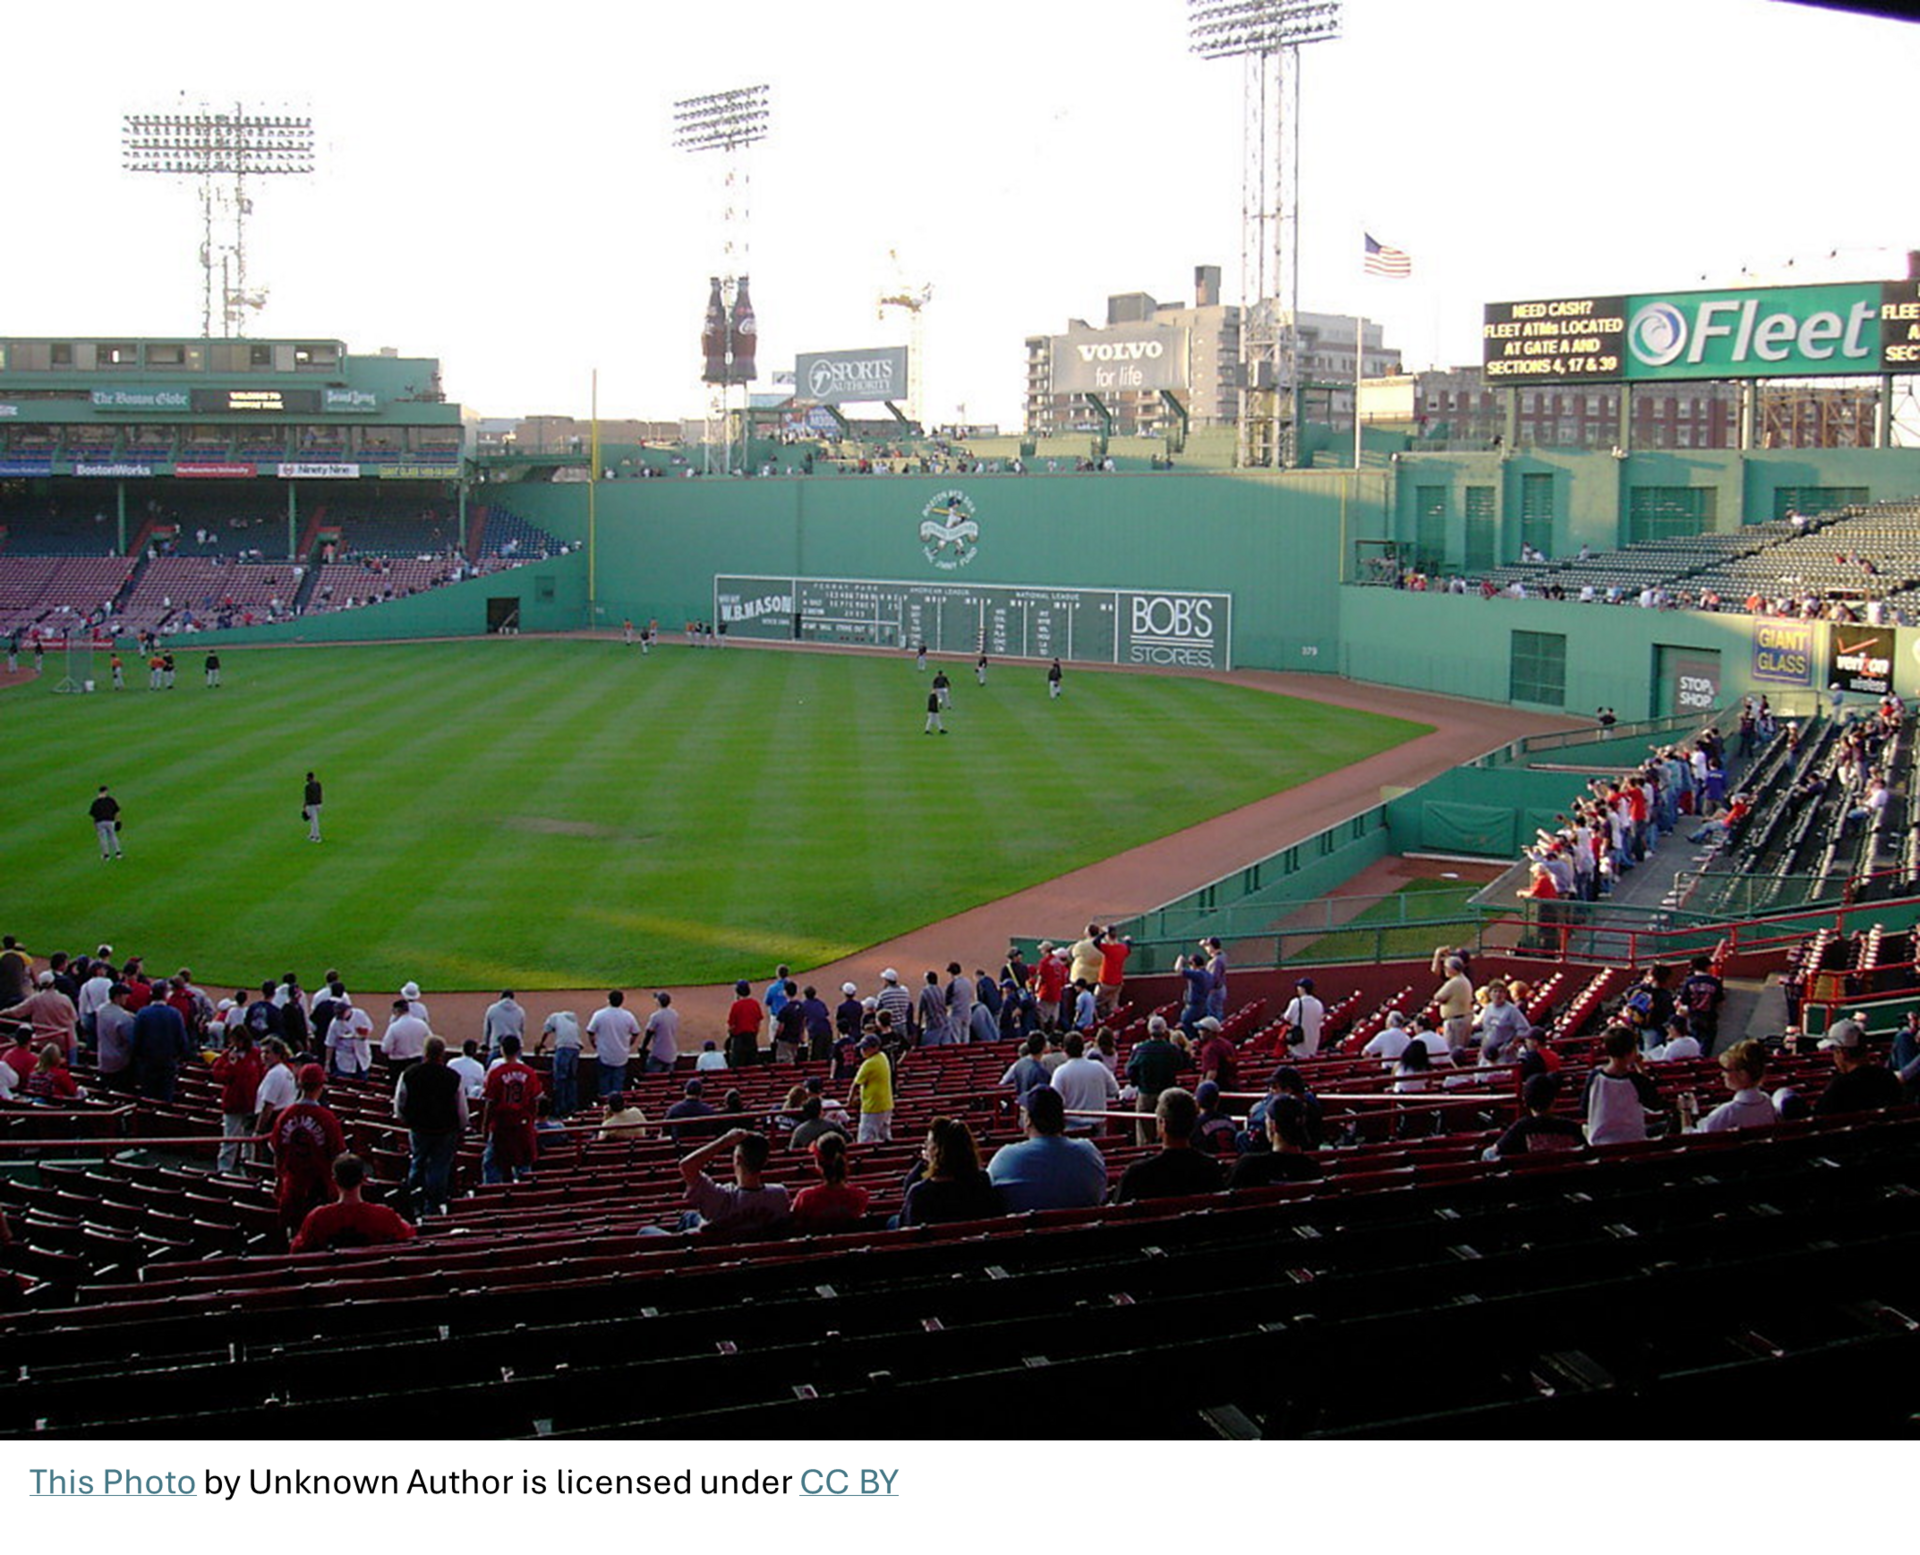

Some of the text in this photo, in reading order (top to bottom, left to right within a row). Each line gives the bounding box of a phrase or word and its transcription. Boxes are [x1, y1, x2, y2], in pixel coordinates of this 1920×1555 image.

[1512, 300, 1593, 318] NEED CASH?
[1484, 318, 1624, 338] FLEET ATMs LOCATED
[1687, 299, 1875, 363] Fleet
[1077, 341, 1163, 361] VOLVO
[1504, 338, 1600, 356] AT GATE A AND
[831, 359, 892, 381] SPORTS
[1487, 356, 1618, 375] SECTIONS 4, 17 & 39
[1096, 365, 1143, 387] for life
[832, 380, 890, 392] AUTHORITY
[93, 391, 187, 405] The Boston Globe
[76, 464, 150, 476] BostonWorks
[299, 465, 349, 476] Ninety Nine
[1132, 597, 1213, 638] BOB'S
[1759, 628, 1807, 651] GIANT
[1758, 652, 1806, 675] GLASS
[1837, 652, 1889, 677] verizon
[1680, 676, 1711, 692] STOP
[1850, 677, 1888, 692] wireless
[1680, 691, 1711, 708] SHOP
